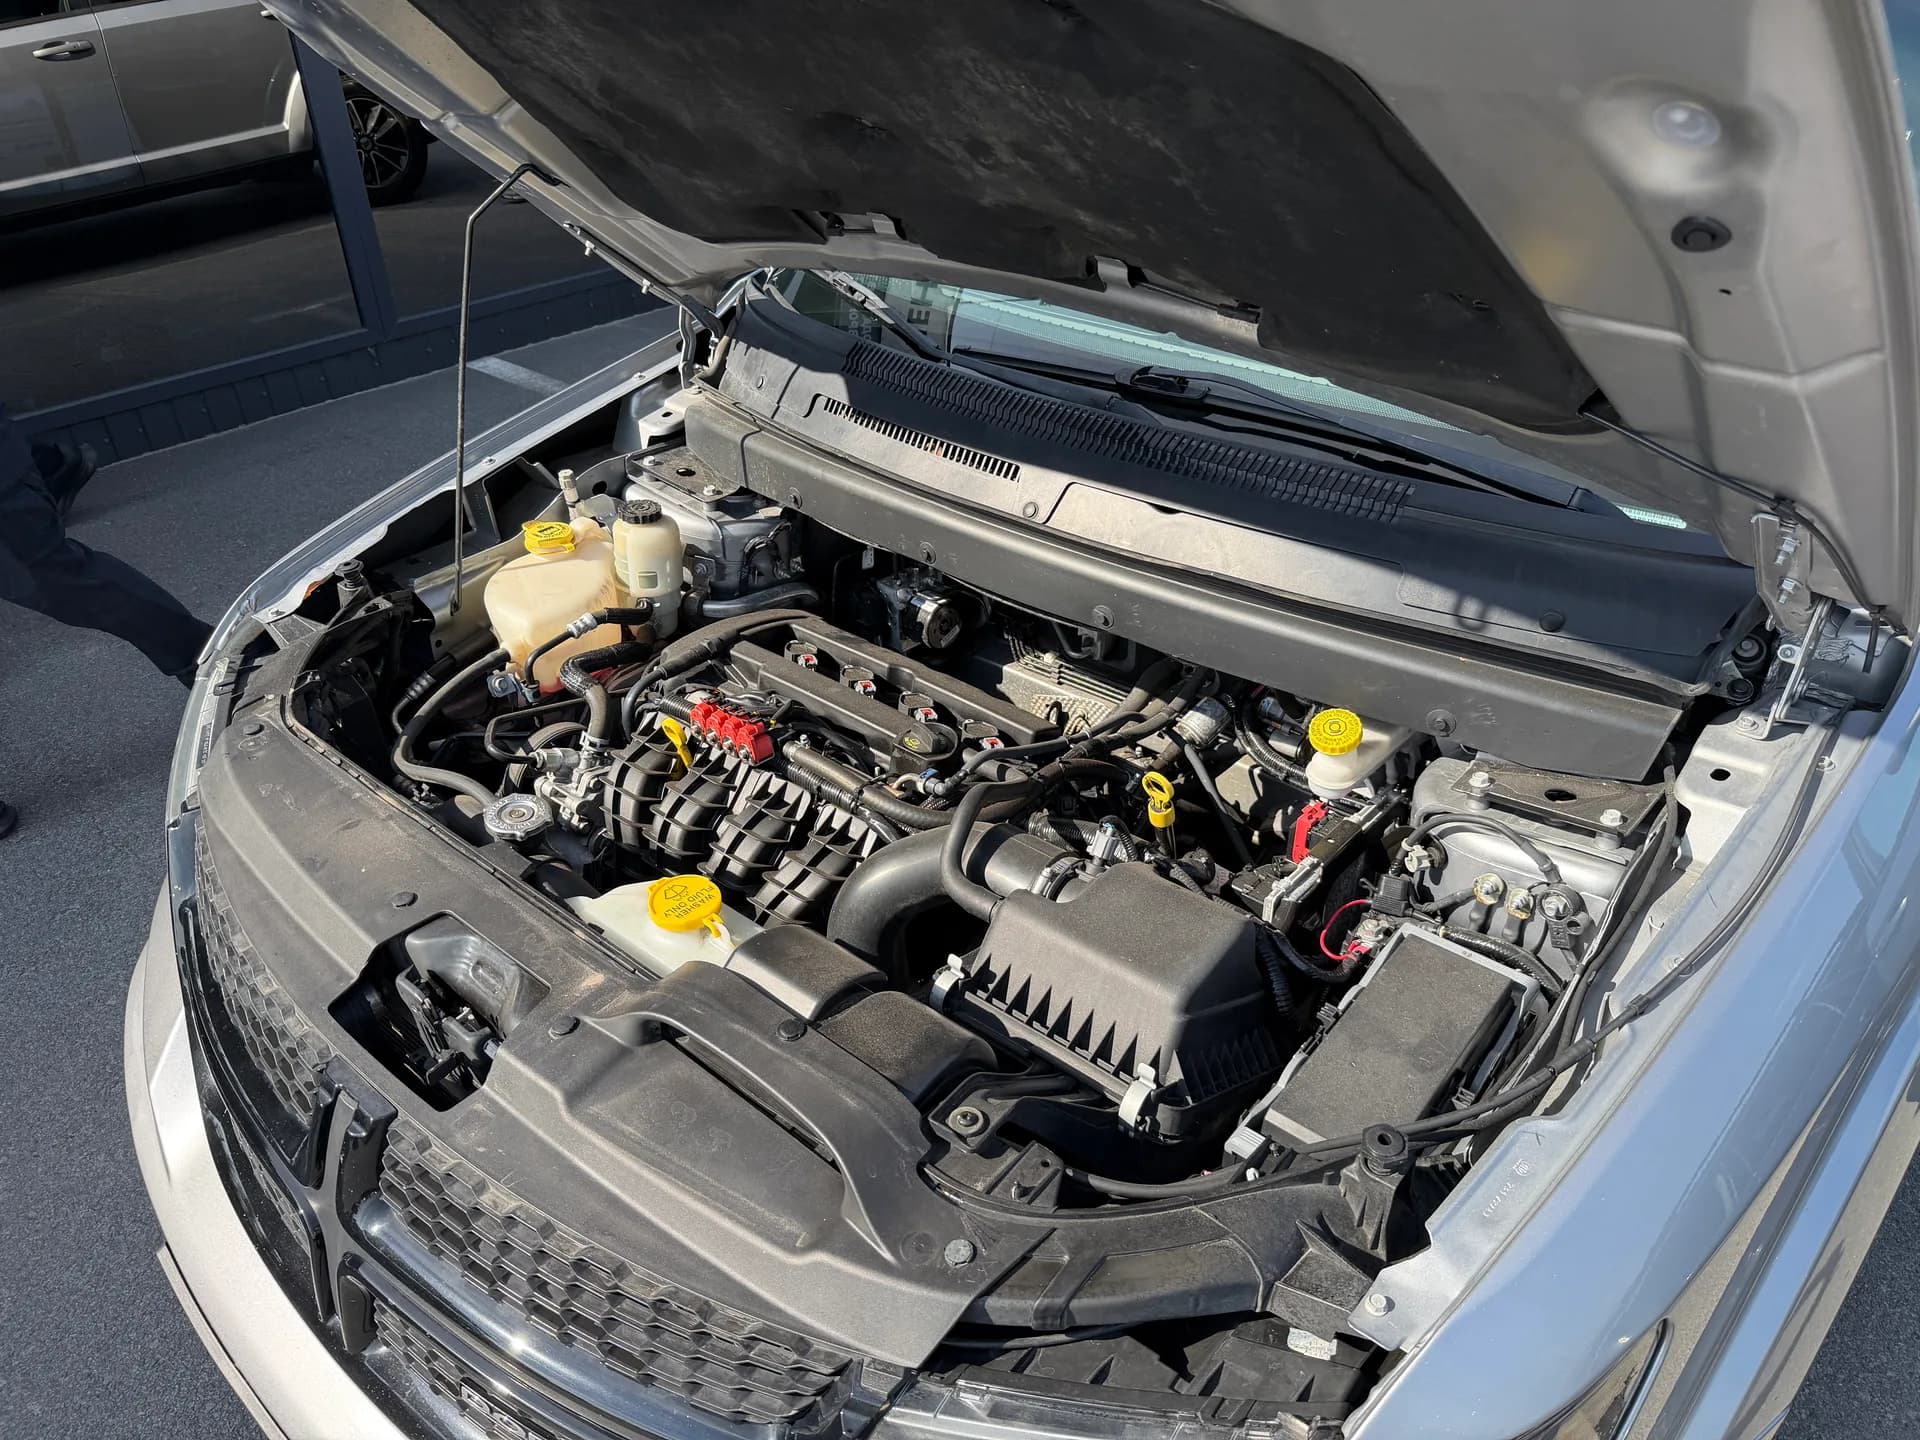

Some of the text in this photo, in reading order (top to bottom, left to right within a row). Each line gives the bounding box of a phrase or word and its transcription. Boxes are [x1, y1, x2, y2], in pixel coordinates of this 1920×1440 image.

[663, 886, 715, 918] FLUID ONLY
[674, 893, 716, 919] WASHER
[460, 1385, 540, 1440] DO
